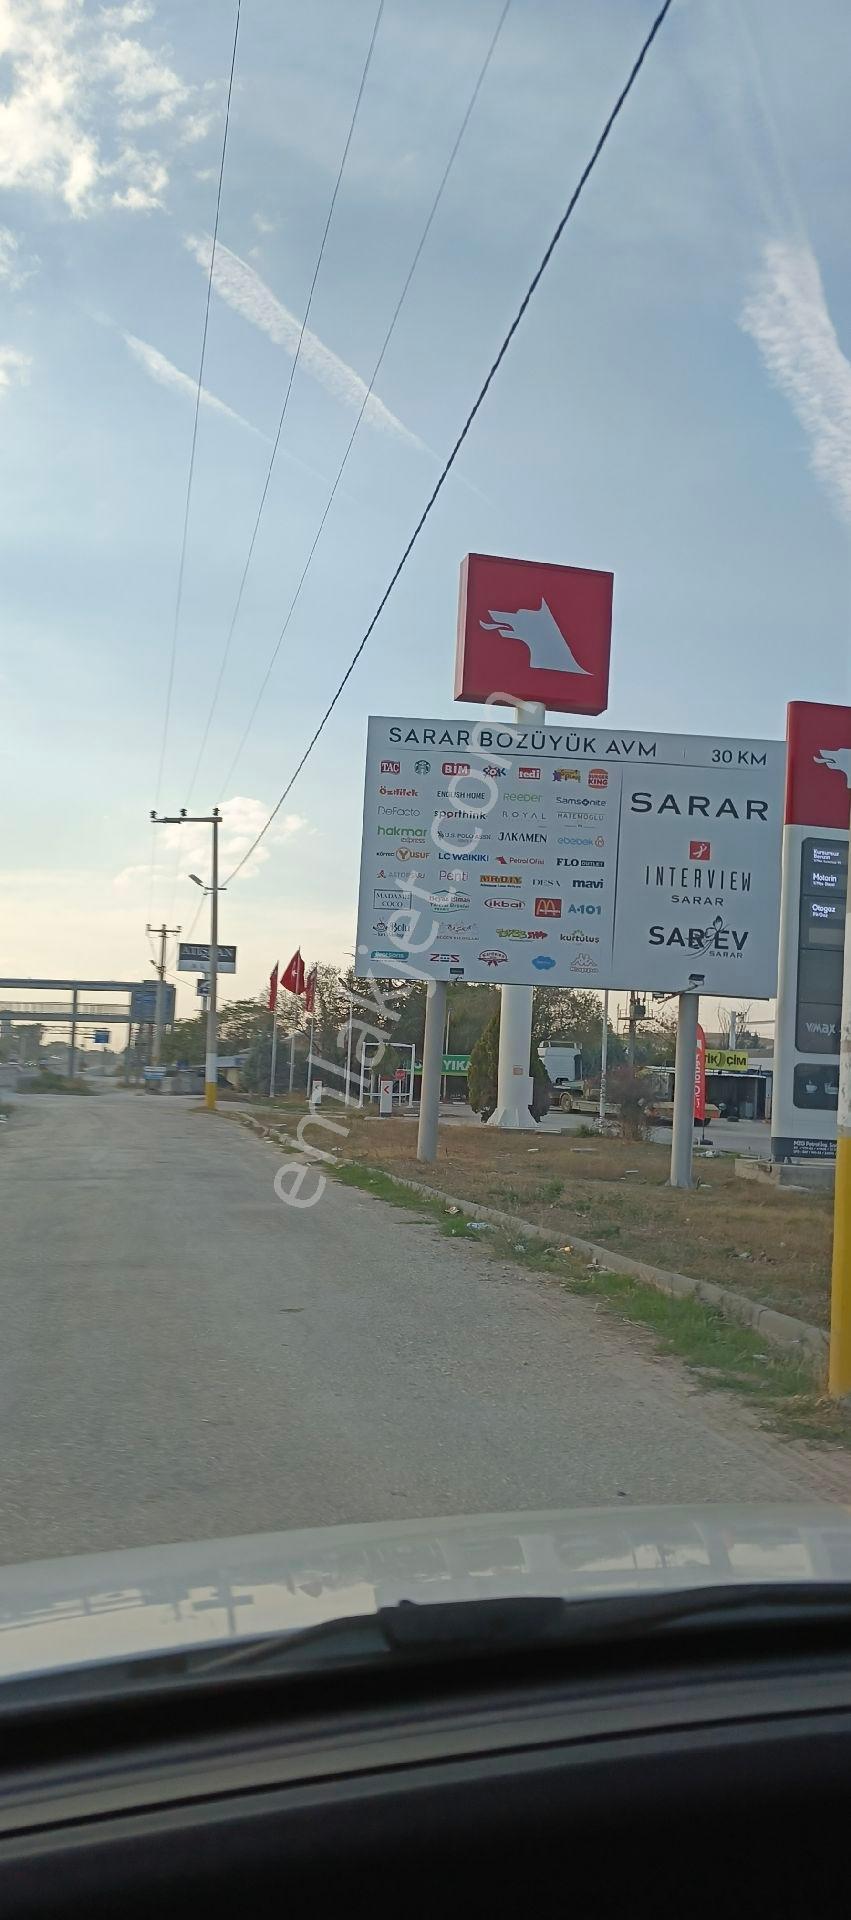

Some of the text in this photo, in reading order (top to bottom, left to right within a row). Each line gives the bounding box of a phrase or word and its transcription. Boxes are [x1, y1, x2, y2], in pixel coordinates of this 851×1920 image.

[389, 727, 767, 766] SARAR BOZÜYÜK AVM 30 KM
[381, 762, 400, 773] TAC
[437, 790, 486, 800] ENGLISH HOME
[556, 797, 607, 807] Samsonite
[630, 792, 768, 822] SARAR
[378, 806, 420, 817] DeFacto
[434, 809, 488, 820] sporthink
[502, 811, 547, 820] ROYAL
[377, 826, 428, 837] hakmar
[498, 831, 547, 844] JAKAMEN
[396, 848, 430, 860] YUSUF
[438, 852, 450, 860] LC
[509, 856, 528, 864] Petrol
[556, 857, 579, 867] FLO
[439, 870, 469, 881] Penti
[645, 865, 751, 892] INTERVIEW
[812, 872, 837, 883] Motorin
[532, 878, 561, 887] DESA
[572, 879, 604, 889] mavi
[375, 892, 411, 900] MADAME
[671, 894, 724, 907] SARAR
[381, 900, 404, 908] COCO
[812, 903, 836, 914] Otogaz
[430, 953, 460, 963] ZES
[709, 950, 744, 959] SARAR
[726, 1054, 747, 1067] ÇİM
